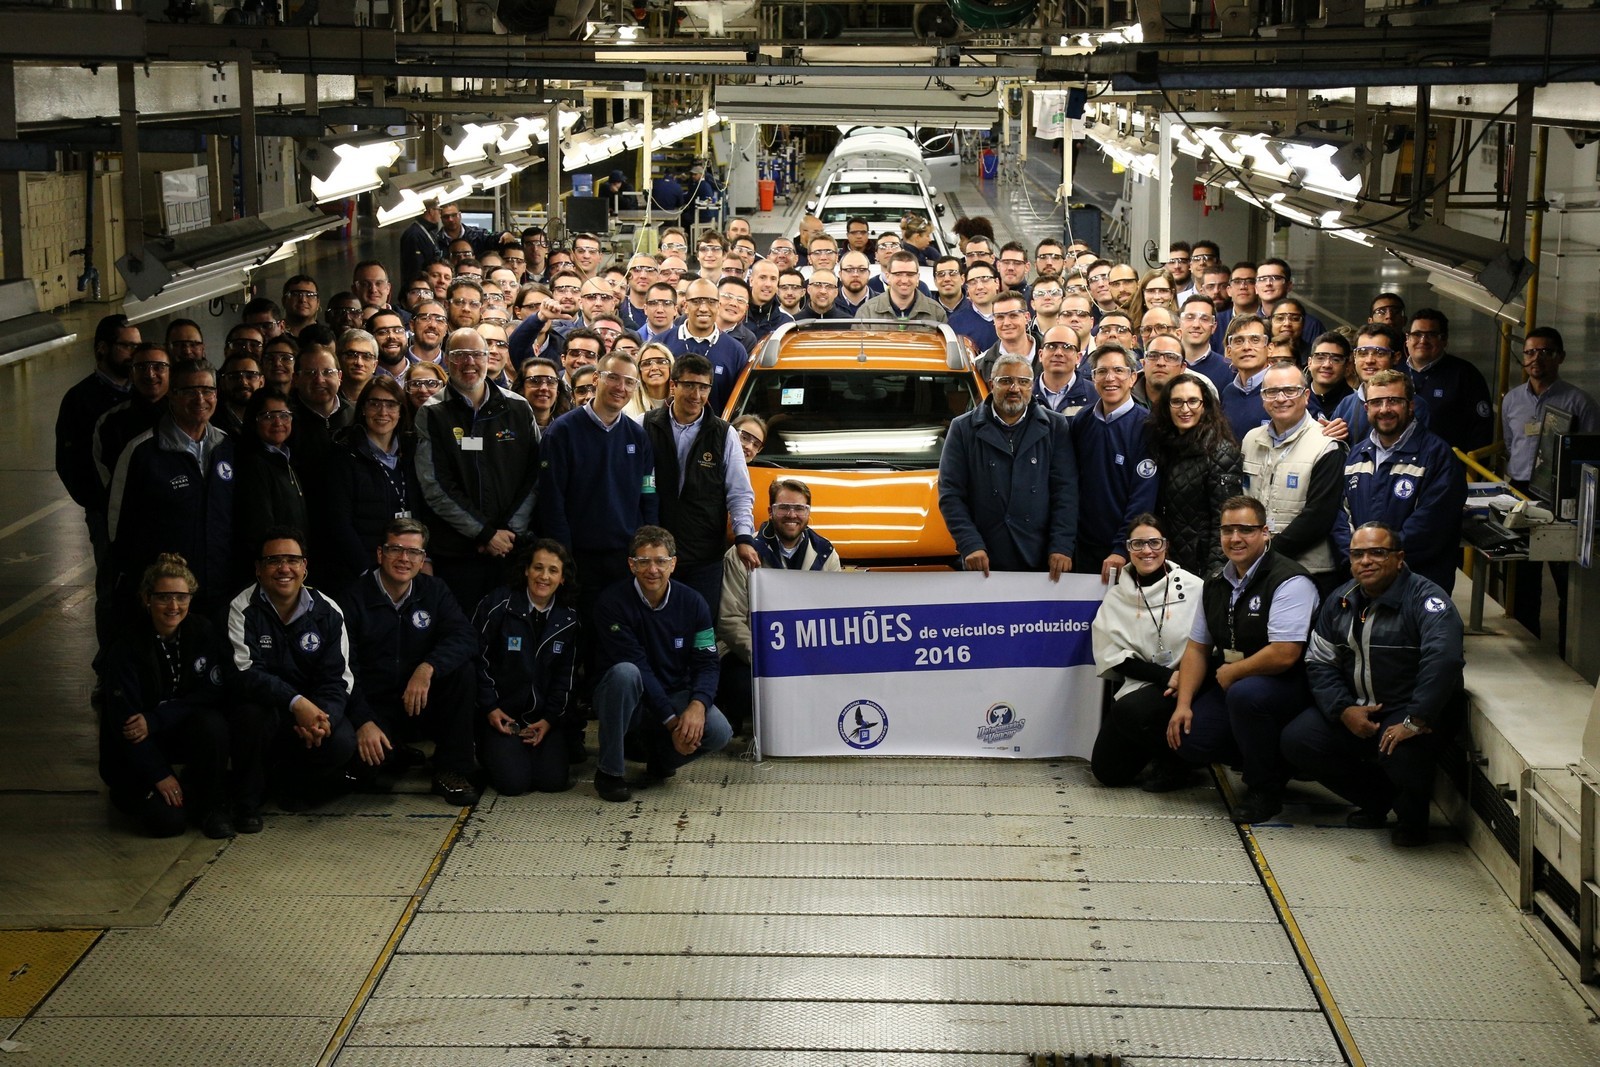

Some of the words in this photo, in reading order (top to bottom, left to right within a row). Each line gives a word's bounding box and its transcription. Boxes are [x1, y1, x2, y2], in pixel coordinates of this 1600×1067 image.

[770, 621, 786, 650] 3
[795, 610, 913, 648] MILHÕES
[919, 626, 938, 639] de
[942, 622, 1005, 638] veículos
[1009, 619, 1089, 637] produzidos
[914, 645, 971, 666] 2016
